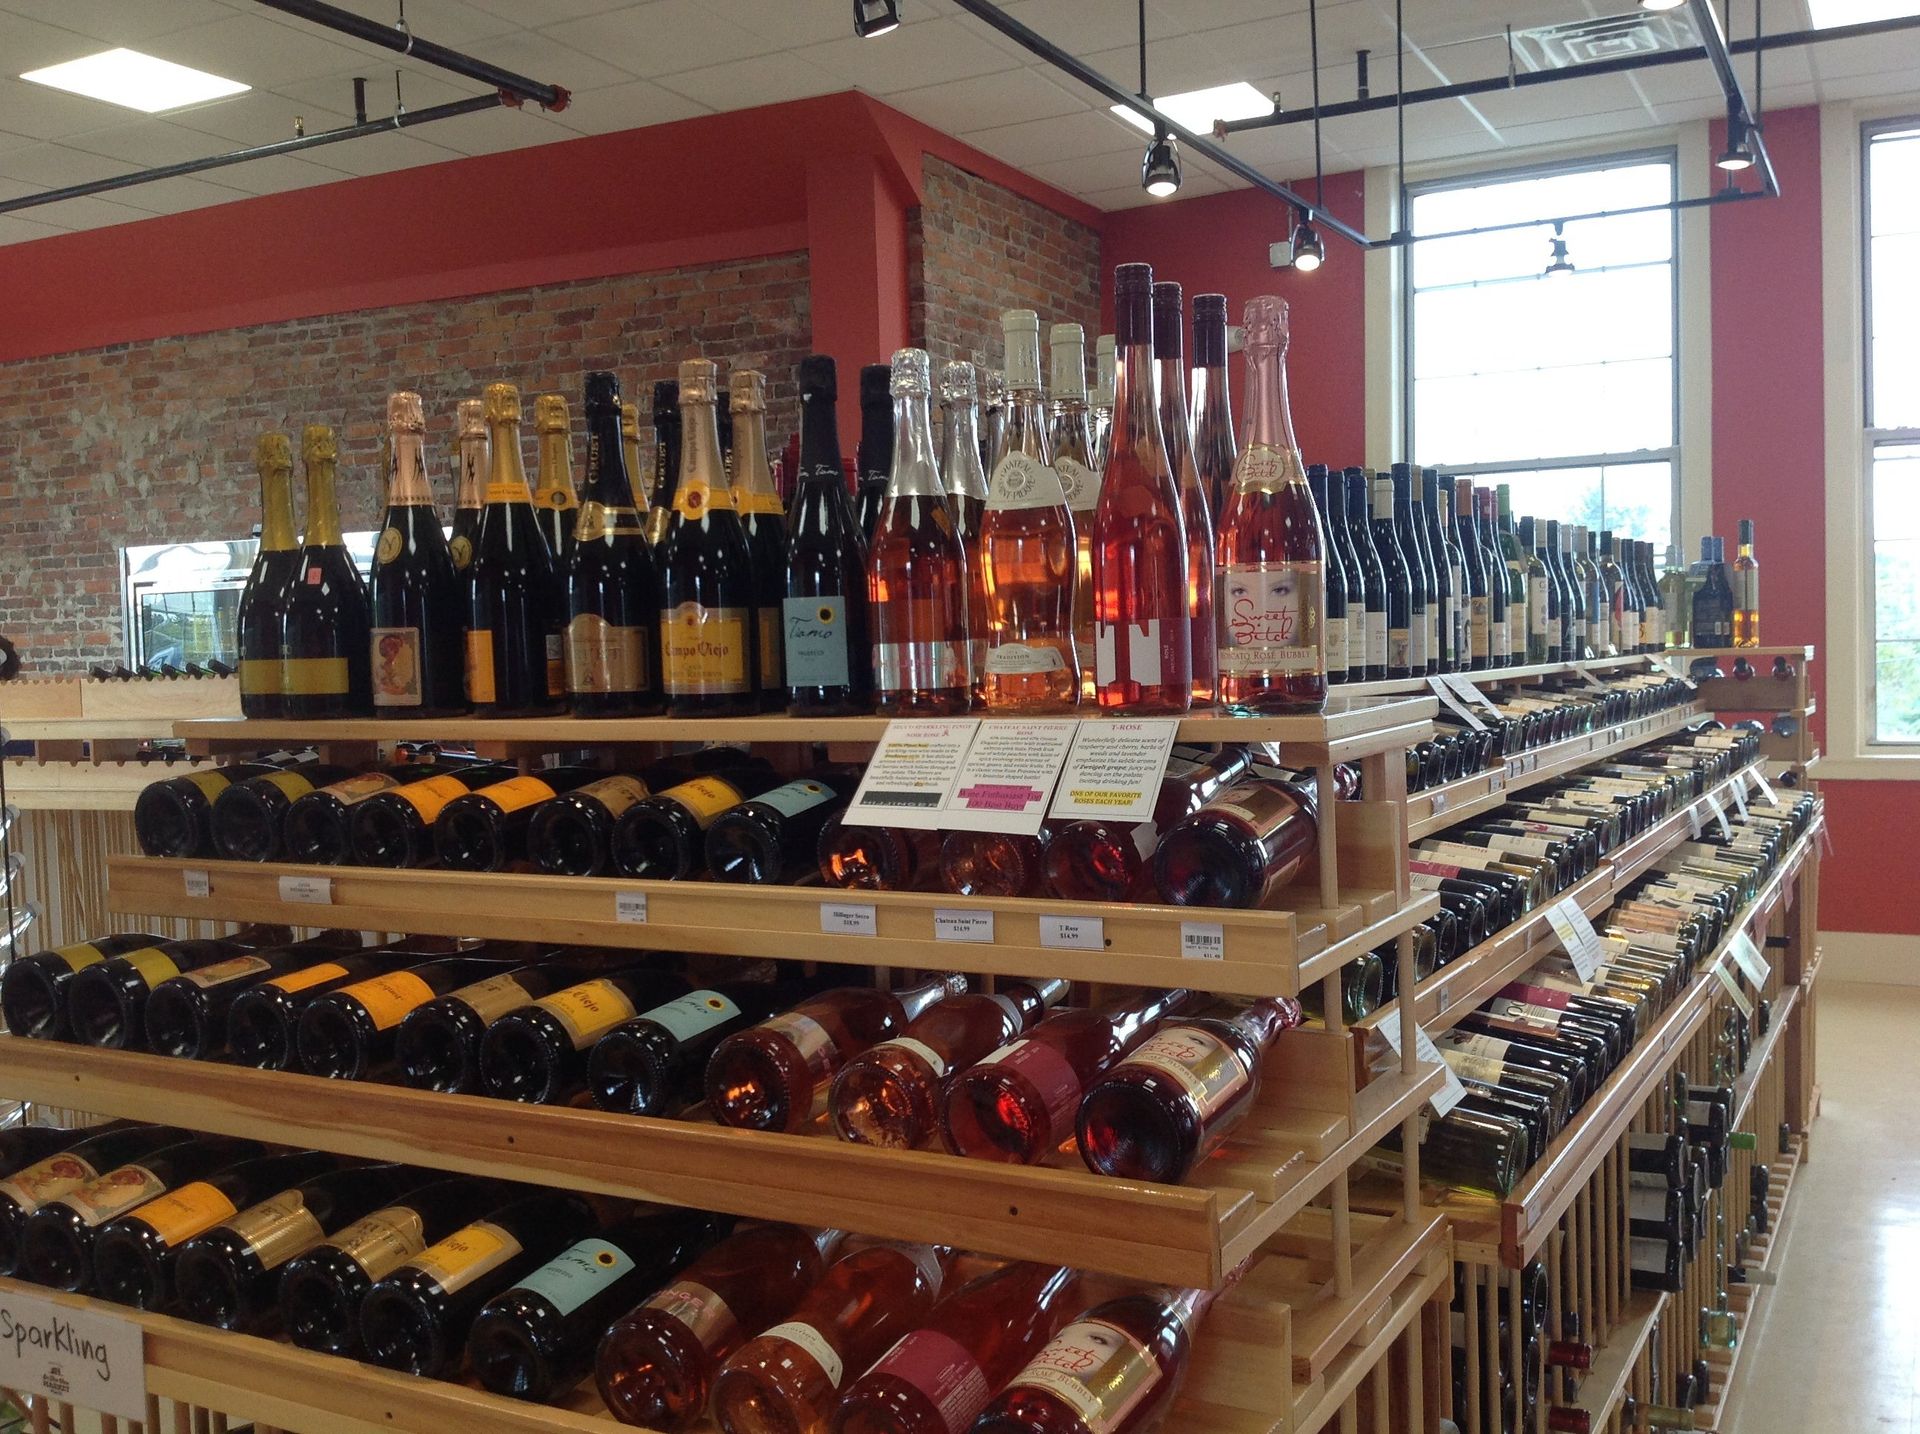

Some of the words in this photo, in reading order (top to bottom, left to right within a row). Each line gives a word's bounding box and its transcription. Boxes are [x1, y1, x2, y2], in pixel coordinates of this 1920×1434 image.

[588, 435, 599, 484] GRUET
[1228, 616, 1293, 645] Bitch
[1232, 598, 1298, 625] Sweet
[0, 1308, 111, 1382] Sparkling
